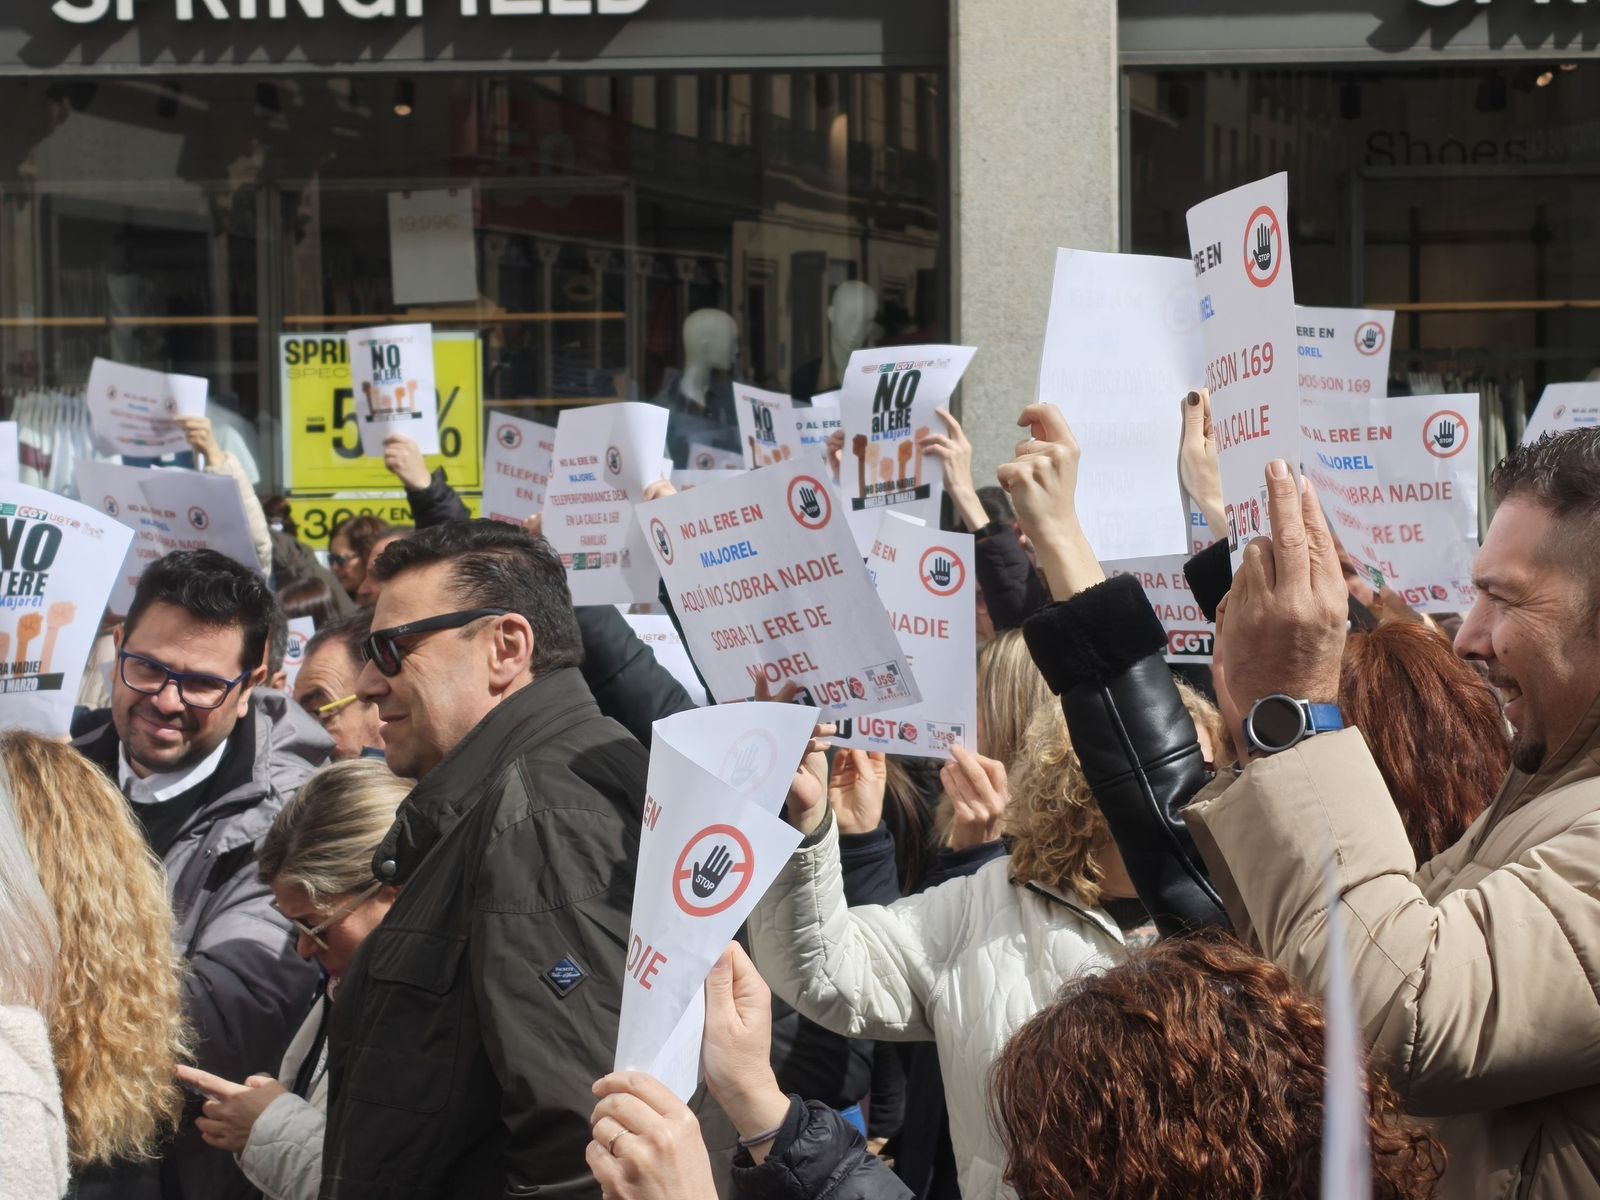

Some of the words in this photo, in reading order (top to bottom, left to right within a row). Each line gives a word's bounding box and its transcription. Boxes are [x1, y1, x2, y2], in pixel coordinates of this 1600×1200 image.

[1206, 241, 1222, 269] EN
[1296, 326, 1316, 338] ERE
[1319, 327, 1335, 339] EN
[371, 344, 400, 371] NO
[1242, 342, 1274, 379] 169
[872, 369, 921, 414] NO
[1347, 378, 1371, 393] 169
[752, 404, 773, 431] NO
[806, 422, 819, 430] AL
[823, 420, 842, 429] ERE
[887, 408, 912, 431] ERE
[1232, 405, 1271, 446] CALLE
[1328, 428, 1361, 444] ERE
[1366, 426, 1393, 441] EN
[569, 472, 597, 483] MAJOREL
[515, 487, 533, 500] EN
[1389, 481, 1454, 504] NADIE
[680, 522, 697, 540] NO
[698, 518, 713, 536] AL
[713, 510, 740, 531] ERE
[740, 503, 763, 523] EN
[1399, 524, 1424, 543] DE
[700, 540, 758, 568] MAJOREL
[882, 545, 896, 562] EN
[7, 571, 48, 596] ERE
[680, 583, 709, 613] AQUÍ
[705, 585, 724, 607] NO
[724, 573, 780, 605] SOBRA
[777, 553, 844, 588] NADIE
[934, 574, 949, 583] STOP
[711, 625, 751, 651] SOBRA
[763, 612, 804, 640] ERE
[803, 605, 832, 629] DE
[887, 610, 949, 639] NADIE
[1171, 633, 1212, 653] CGT
[813, 679, 848, 705] UGT
[858, 716, 896, 739] UGT
[644, 795, 662, 832] EN
[695, 874, 715, 892] STOP
